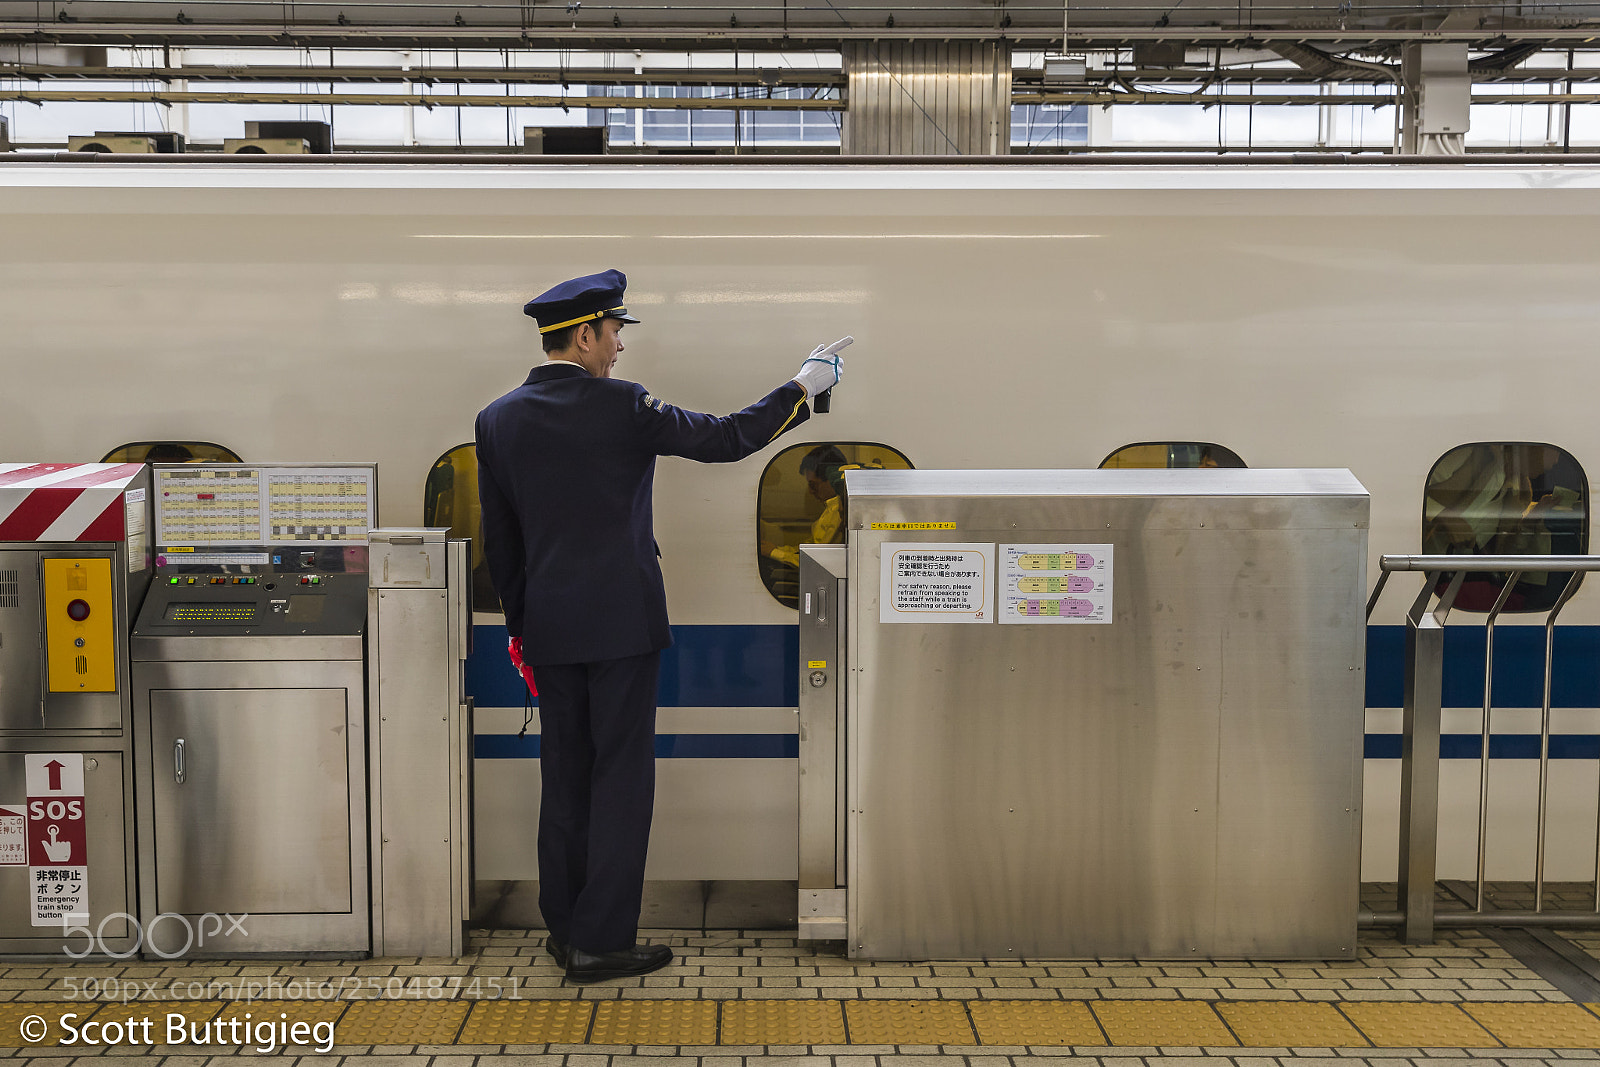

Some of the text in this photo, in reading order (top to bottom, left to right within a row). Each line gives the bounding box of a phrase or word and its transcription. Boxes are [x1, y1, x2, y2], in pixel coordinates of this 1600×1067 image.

[898, 562, 950, 570] 安全確認を行うため
[30, 800, 83, 821] SOS
[36, 870, 82, 882] 非常停止
[37, 883, 82, 894] ボタン
[37, 895, 80, 904] Emergency
[56, 904, 74, 912] stop
[37, 911, 63, 919] button
